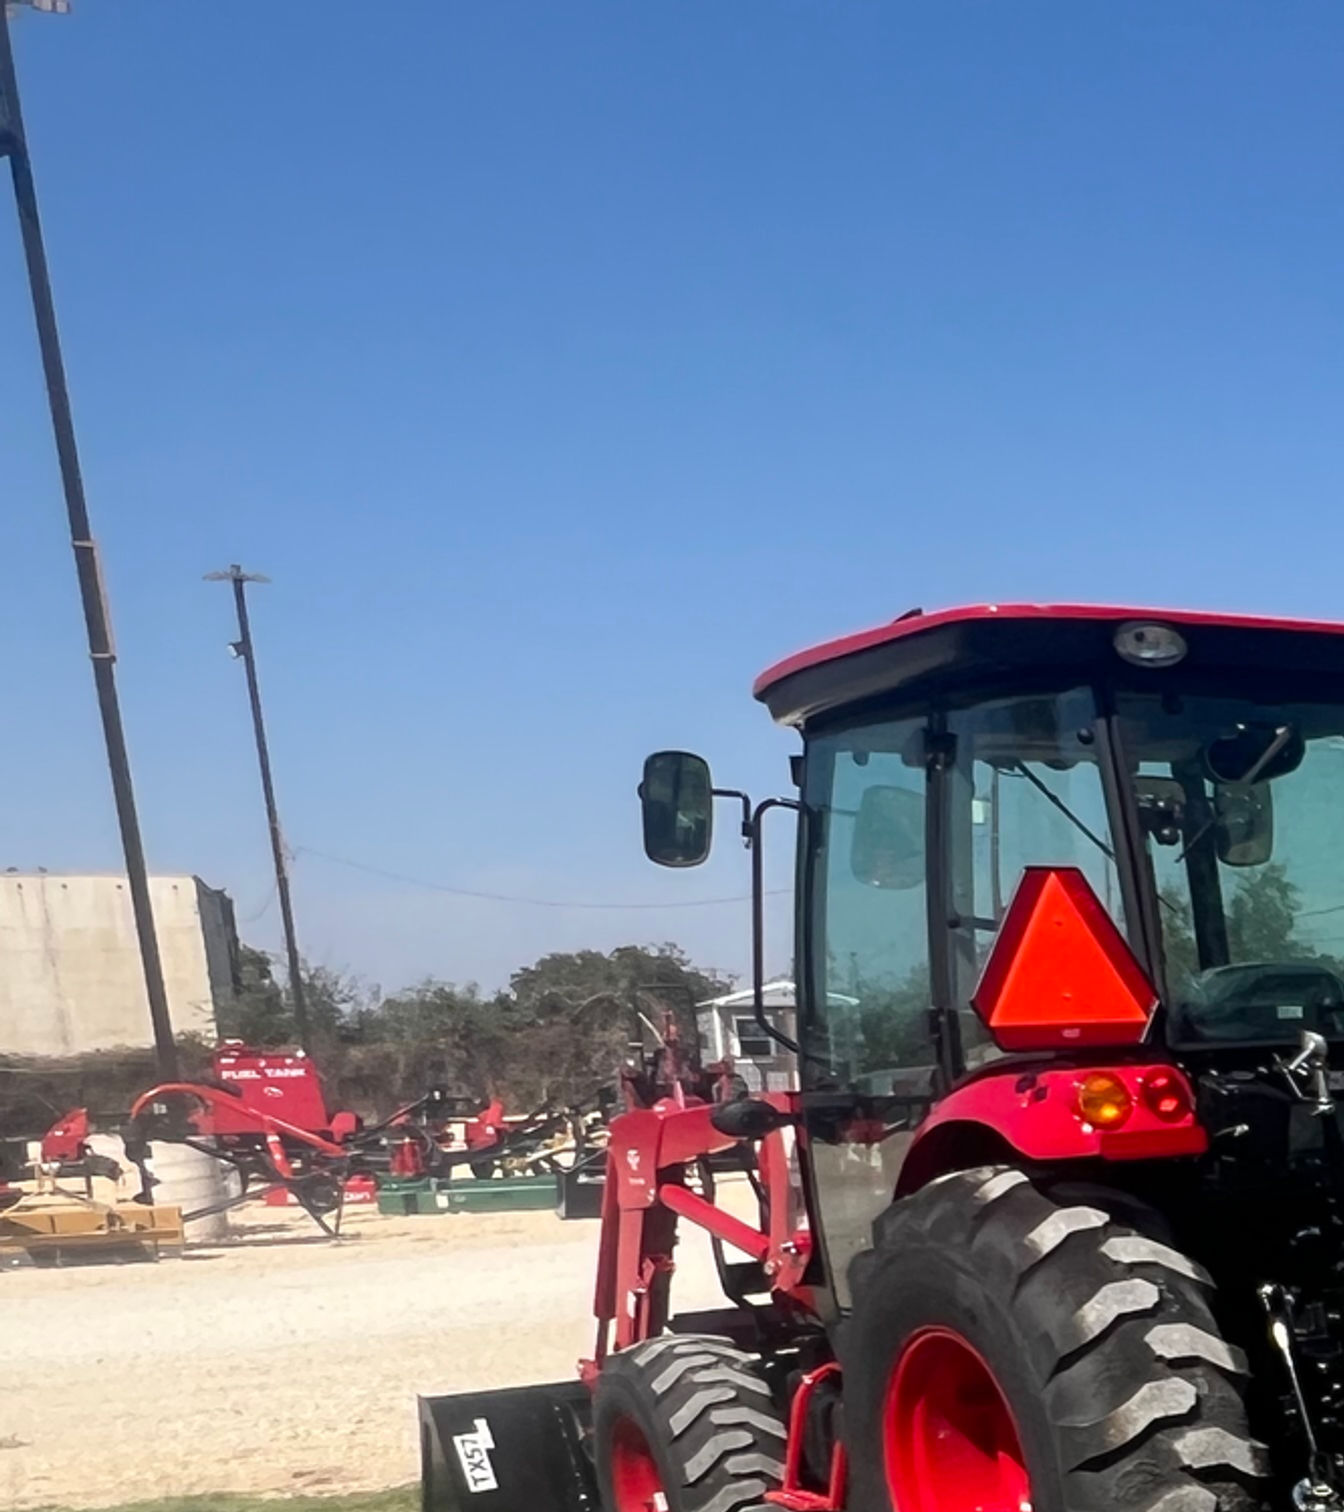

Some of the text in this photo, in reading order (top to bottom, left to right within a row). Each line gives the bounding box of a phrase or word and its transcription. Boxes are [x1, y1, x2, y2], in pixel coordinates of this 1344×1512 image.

[221, 1068, 306, 1080] FUEL TANK
[460, 1438, 491, 1488] TX57
